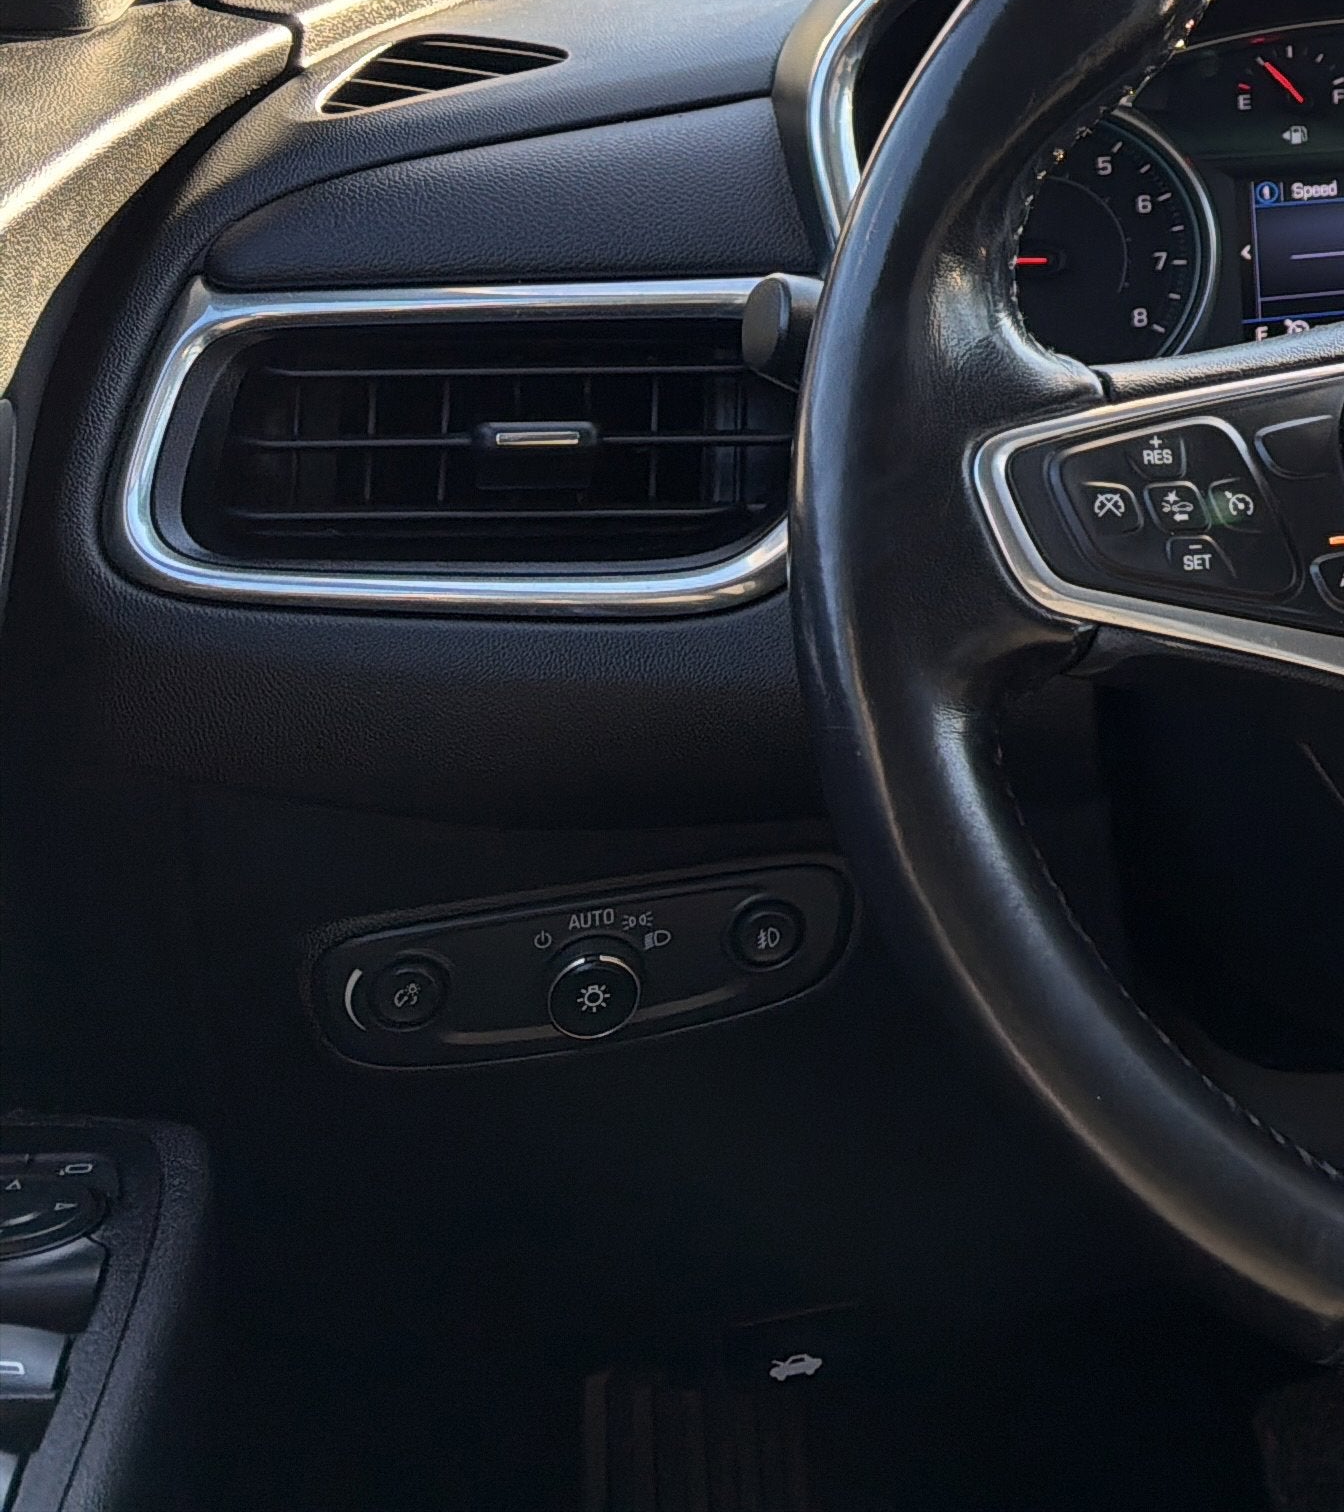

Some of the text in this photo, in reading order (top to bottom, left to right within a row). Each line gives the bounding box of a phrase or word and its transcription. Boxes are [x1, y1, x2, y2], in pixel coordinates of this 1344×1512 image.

[1237, 94, 1252, 111] E
[1096, 156, 1113, 176] 5
[1291, 179, 1339, 201] Speed
[1135, 194, 1152, 214] 6
[1152, 251, 1168, 271] 7
[1130, 307, 1148, 328] 8
[1143, 448, 1173, 466] RES
[1182, 553, 1212, 571] SET
[567, 907, 616, 932] AUTO
